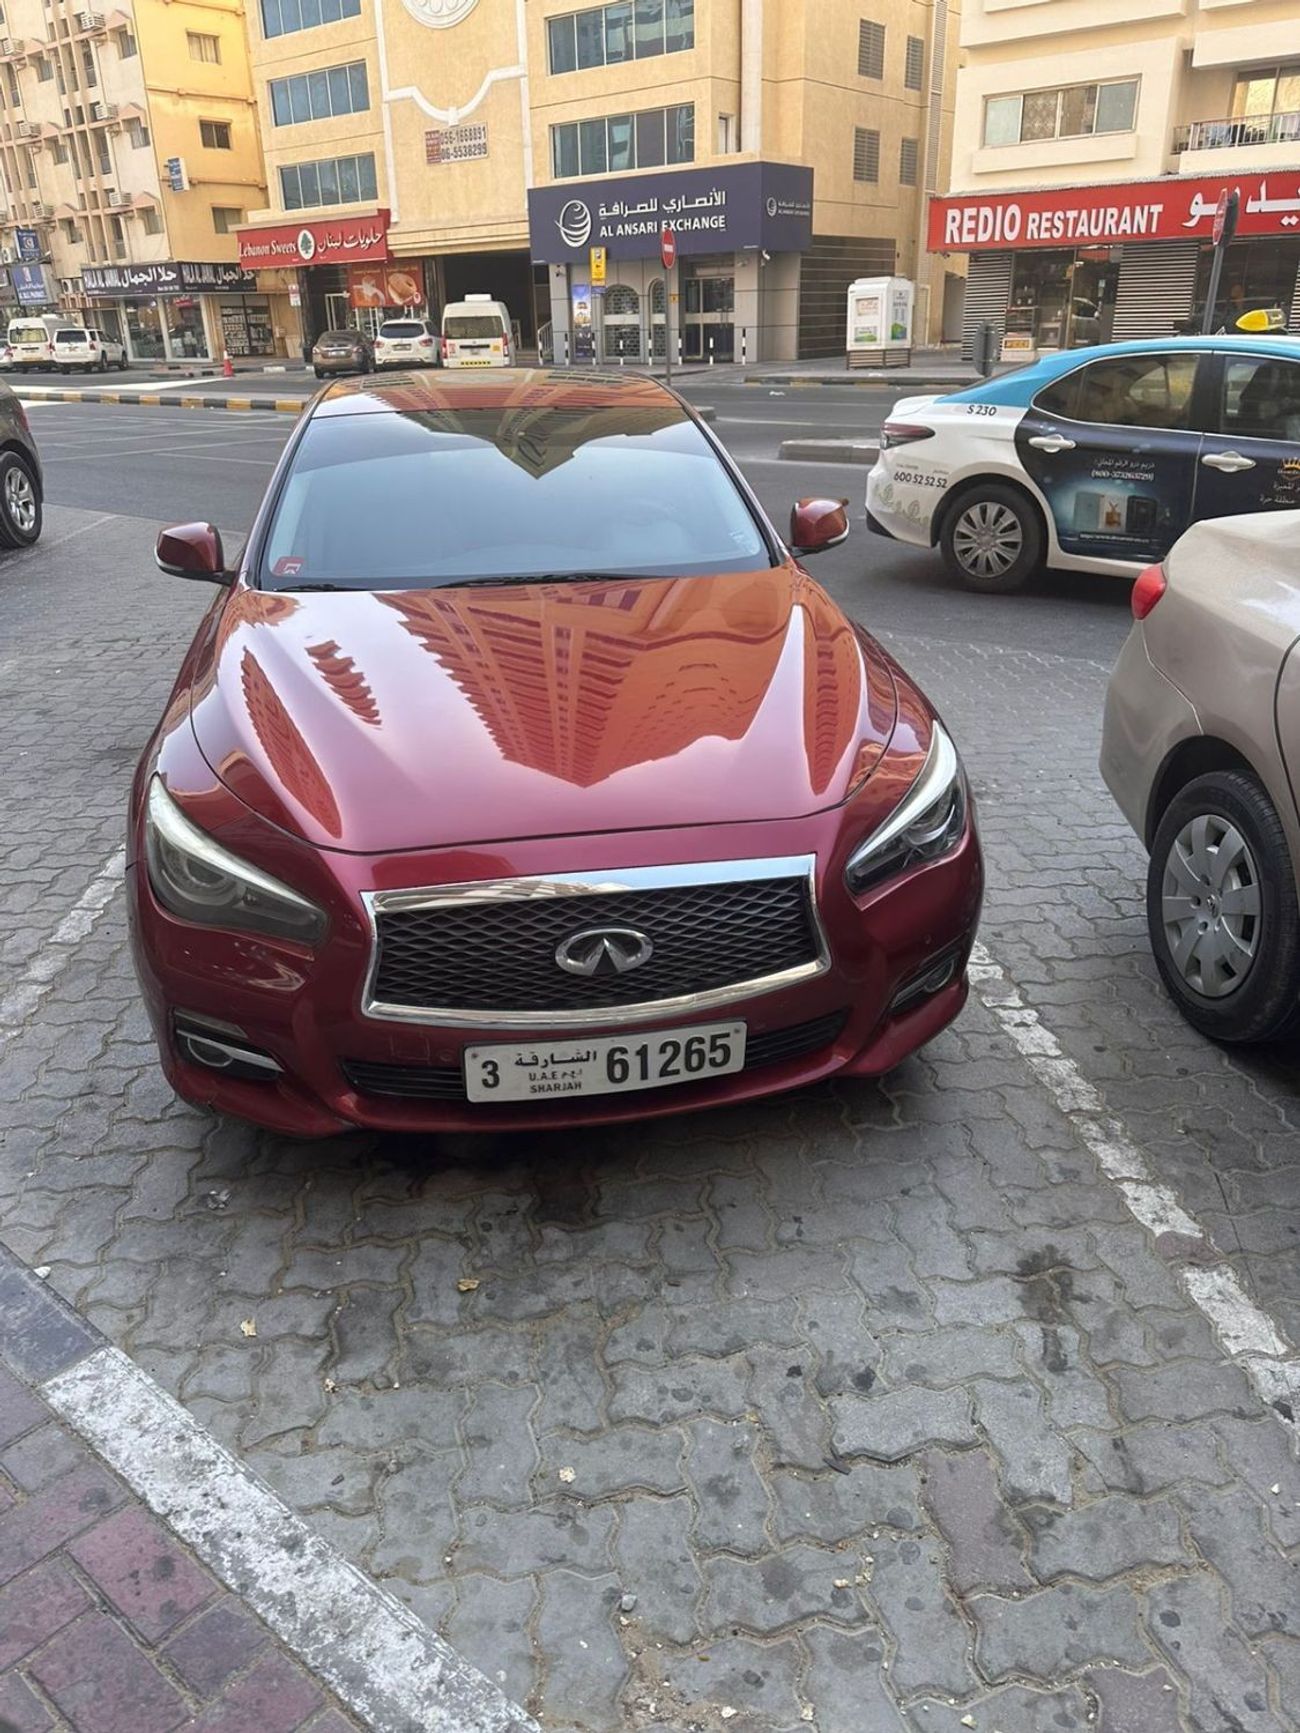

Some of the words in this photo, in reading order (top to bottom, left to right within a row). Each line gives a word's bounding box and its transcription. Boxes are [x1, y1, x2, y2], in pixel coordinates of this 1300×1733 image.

[599, 198, 658, 220] للصرافة
[662, 187, 726, 214] الأنصاري
[600, 224, 614, 238] AL
[616, 221, 658, 237] ANSARI
[661, 215, 726, 232] EXCHANGE
[944, 203, 1022, 244] REDIO
[1026, 204, 1164, 240] RESTAURANT
[239, 241, 270, 258] Lebanon
[270, 239, 297, 255] Sweets
[316, 232, 342, 253] لبنان
[343, 227, 384, 250] حلويات
[122, 267, 157, 288] الجمال
[967, 405, 975, 415] S
[976, 405, 997, 417] 230
[894, 472, 912, 483] 600
[912, 474, 924, 485] 52
[924, 476, 936, 487] 52
[936, 478, 948, 489] 52
[514, 1049, 597, 1069] الشارقة
[606, 1032, 731, 1084] 61265
[481, 1060, 500, 1089] 3
[529, 1082, 582, 1094] SHARJAH
